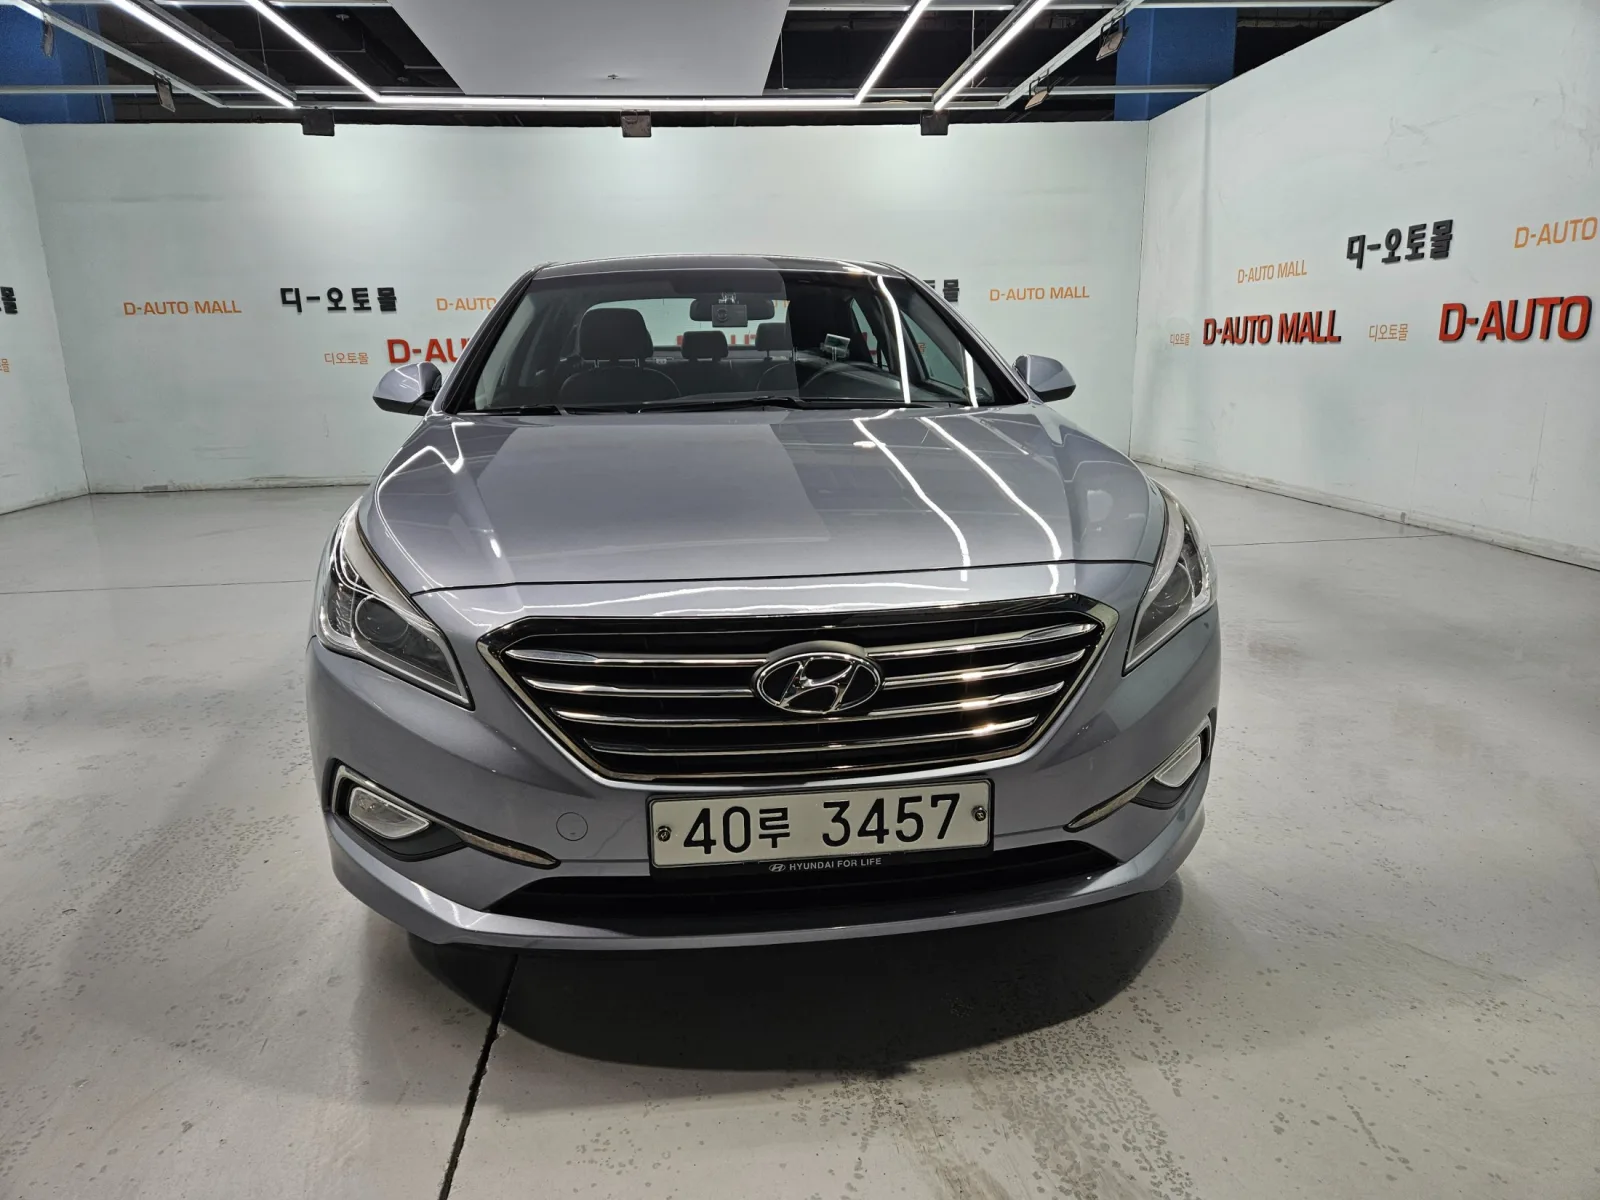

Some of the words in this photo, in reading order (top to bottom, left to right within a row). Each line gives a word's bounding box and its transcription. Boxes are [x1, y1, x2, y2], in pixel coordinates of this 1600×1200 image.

[1346, 219, 1454, 270] 디-오토몰
[1514, 216, 1598, 248] D-AUTO
[1237, 264, 1274, 284] D-AUTO
[1277, 259, 1308, 279] MALL
[280, 287, 397, 313] 디-오토몰
[989, 287, 1046, 302] D-AUTO
[1049, 286, 1090, 300] MALL
[123, 302, 189, 316] D-AUTO
[194, 300, 242, 314] MALL
[1438, 295, 1592, 342] D-AUTO
[1169, 333, 1190, 347] 디오토몰
[1202, 314, 1273, 346] D-AUTO
[1277, 310, 1342, 345] MALL
[1368, 323, 1409, 342] 디오토몰
[324, 352, 369, 365] 디오토몰
[387, 338, 471, 364] D-AU
[683, 806, 790, 855] 40루
[822, 793, 961, 846] 3457
[789, 861, 835, 871] HYUNDAI
[837, 859, 858, 869] FOR
[860, 857, 882, 867] LIFE
